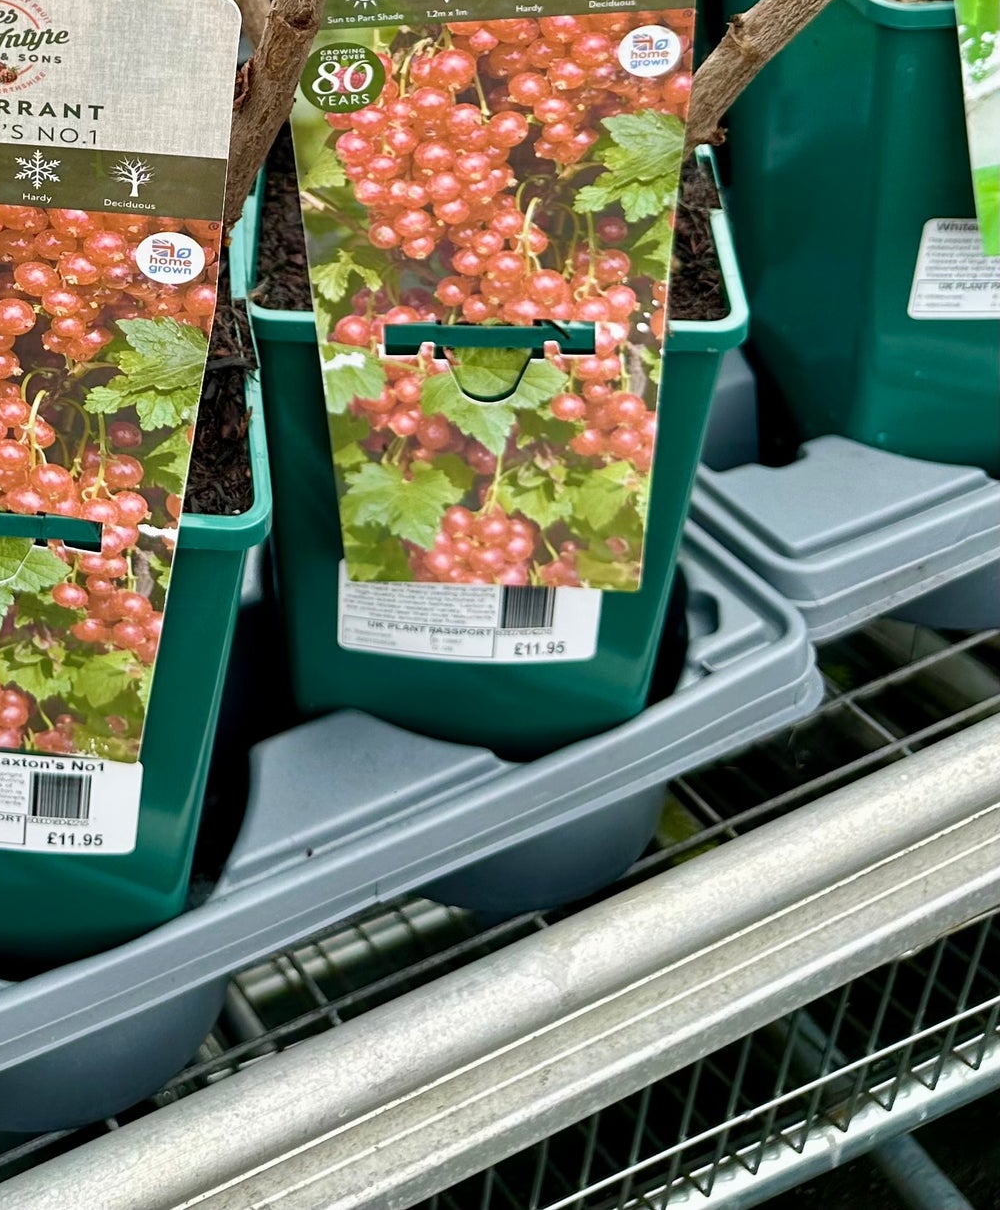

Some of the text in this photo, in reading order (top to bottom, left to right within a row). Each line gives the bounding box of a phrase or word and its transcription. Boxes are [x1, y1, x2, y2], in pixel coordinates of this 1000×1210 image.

[516, 5, 543, 13] Hardy
[589, 0, 636, 8] Deciduous
[31, 3, 52, 24] FRUIT
[328, 16, 344, 24] Sun
[378, 13, 404, 21] Shade
[426, 10, 446, 18] 1.2m
[320, 48, 366, 56] GROWING
[630, 50, 669, 58] home
[18, 54, 62, 63] SONS
[630, 58, 669, 68] grown
[312, 60, 374, 95] 80
[316, 94, 370, 106] YEARS
[38, 126, 97, 144] NO.1
[22, 193, 52, 204] Hardy
[104, 199, 156, 210] Deciduous
[149, 255, 192, 267] home
[149, 265, 192, 275] grown
[368, 621, 384, 629] UK
[388, 623, 425, 632] PLANT
[429, 627, 492, 636] PASSPORT
[514, 641, 566, 655] £11.95
[71, 760, 105, 772] No1
[47, 832, 103, 846] £11.95
